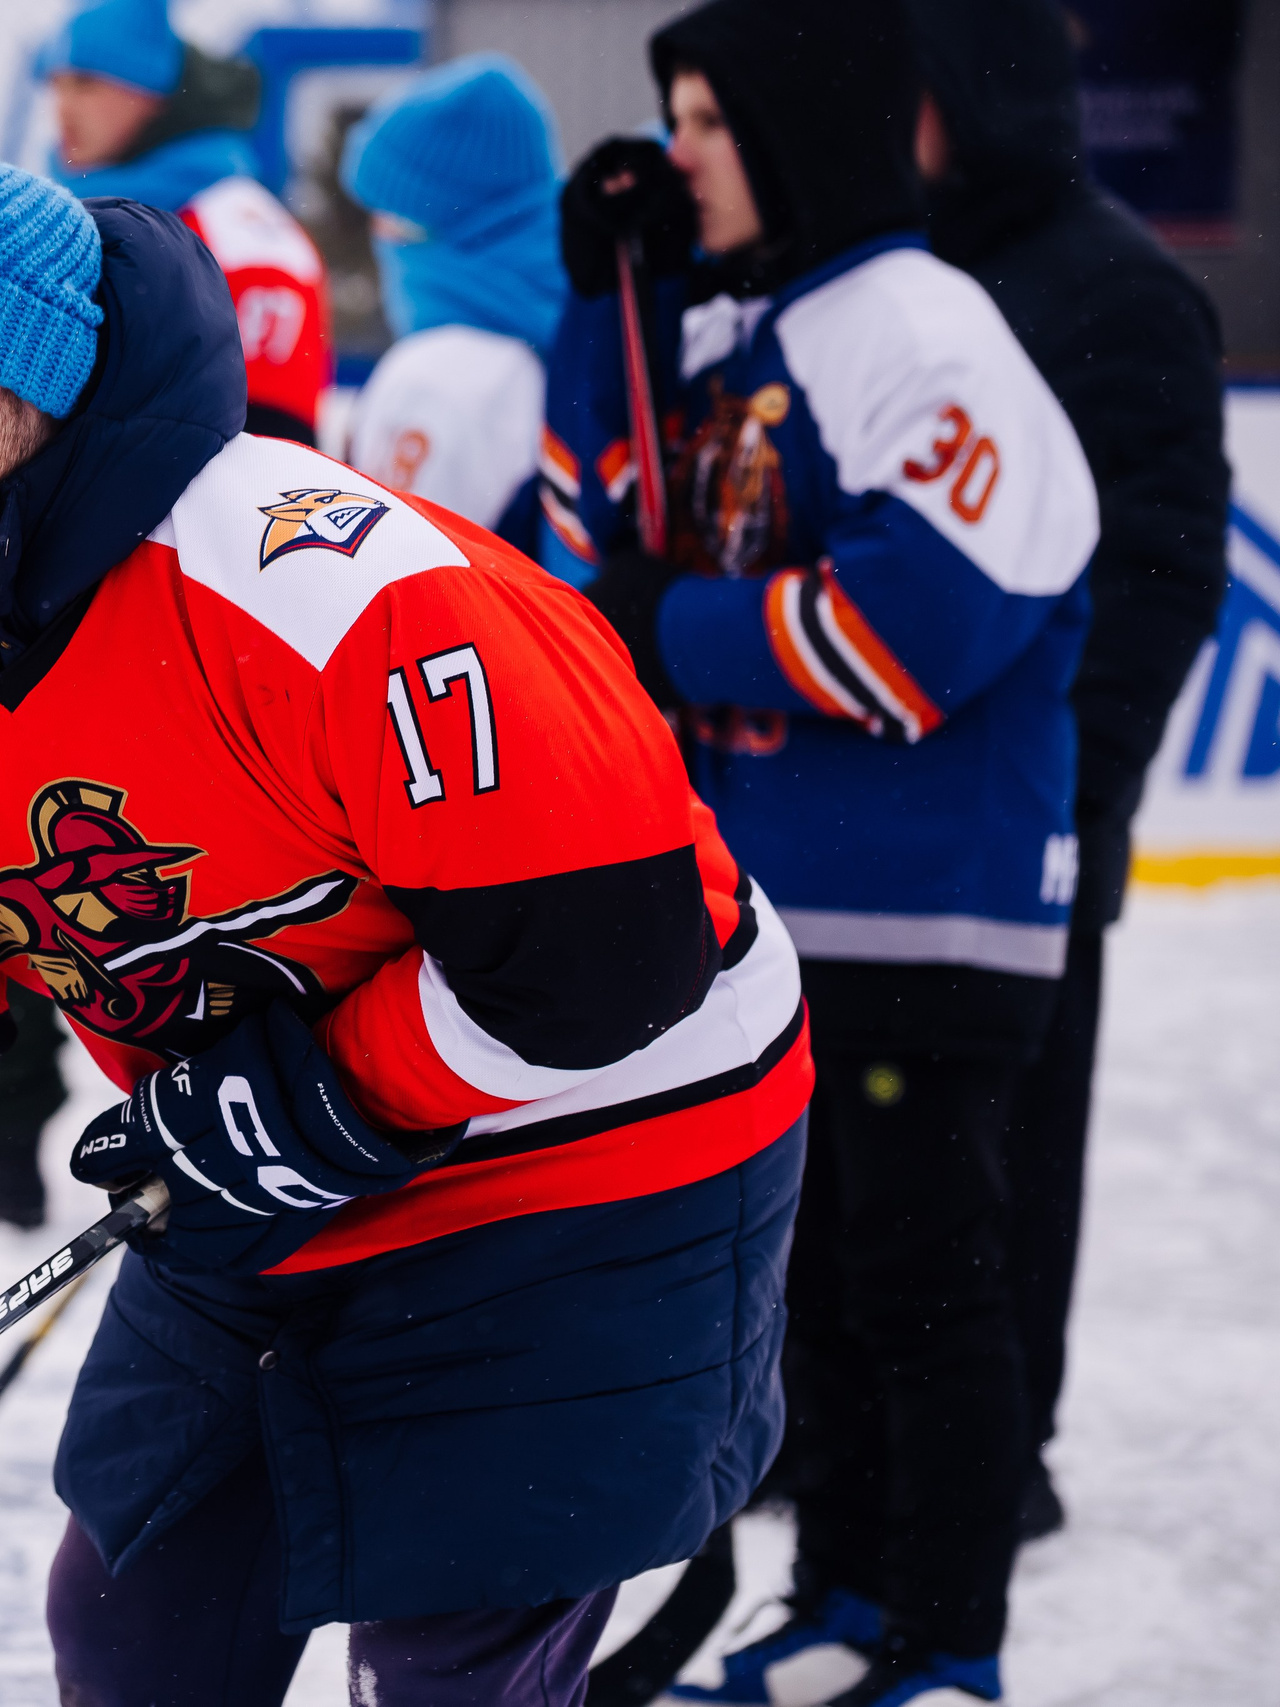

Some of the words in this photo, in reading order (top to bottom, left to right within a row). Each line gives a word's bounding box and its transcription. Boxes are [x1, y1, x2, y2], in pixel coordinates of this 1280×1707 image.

[902, 404, 1001, 524] 30
[387, 641, 500, 810] 17
[80, 1133, 127, 1159] CCM
[218, 1076, 358, 1210] CC
